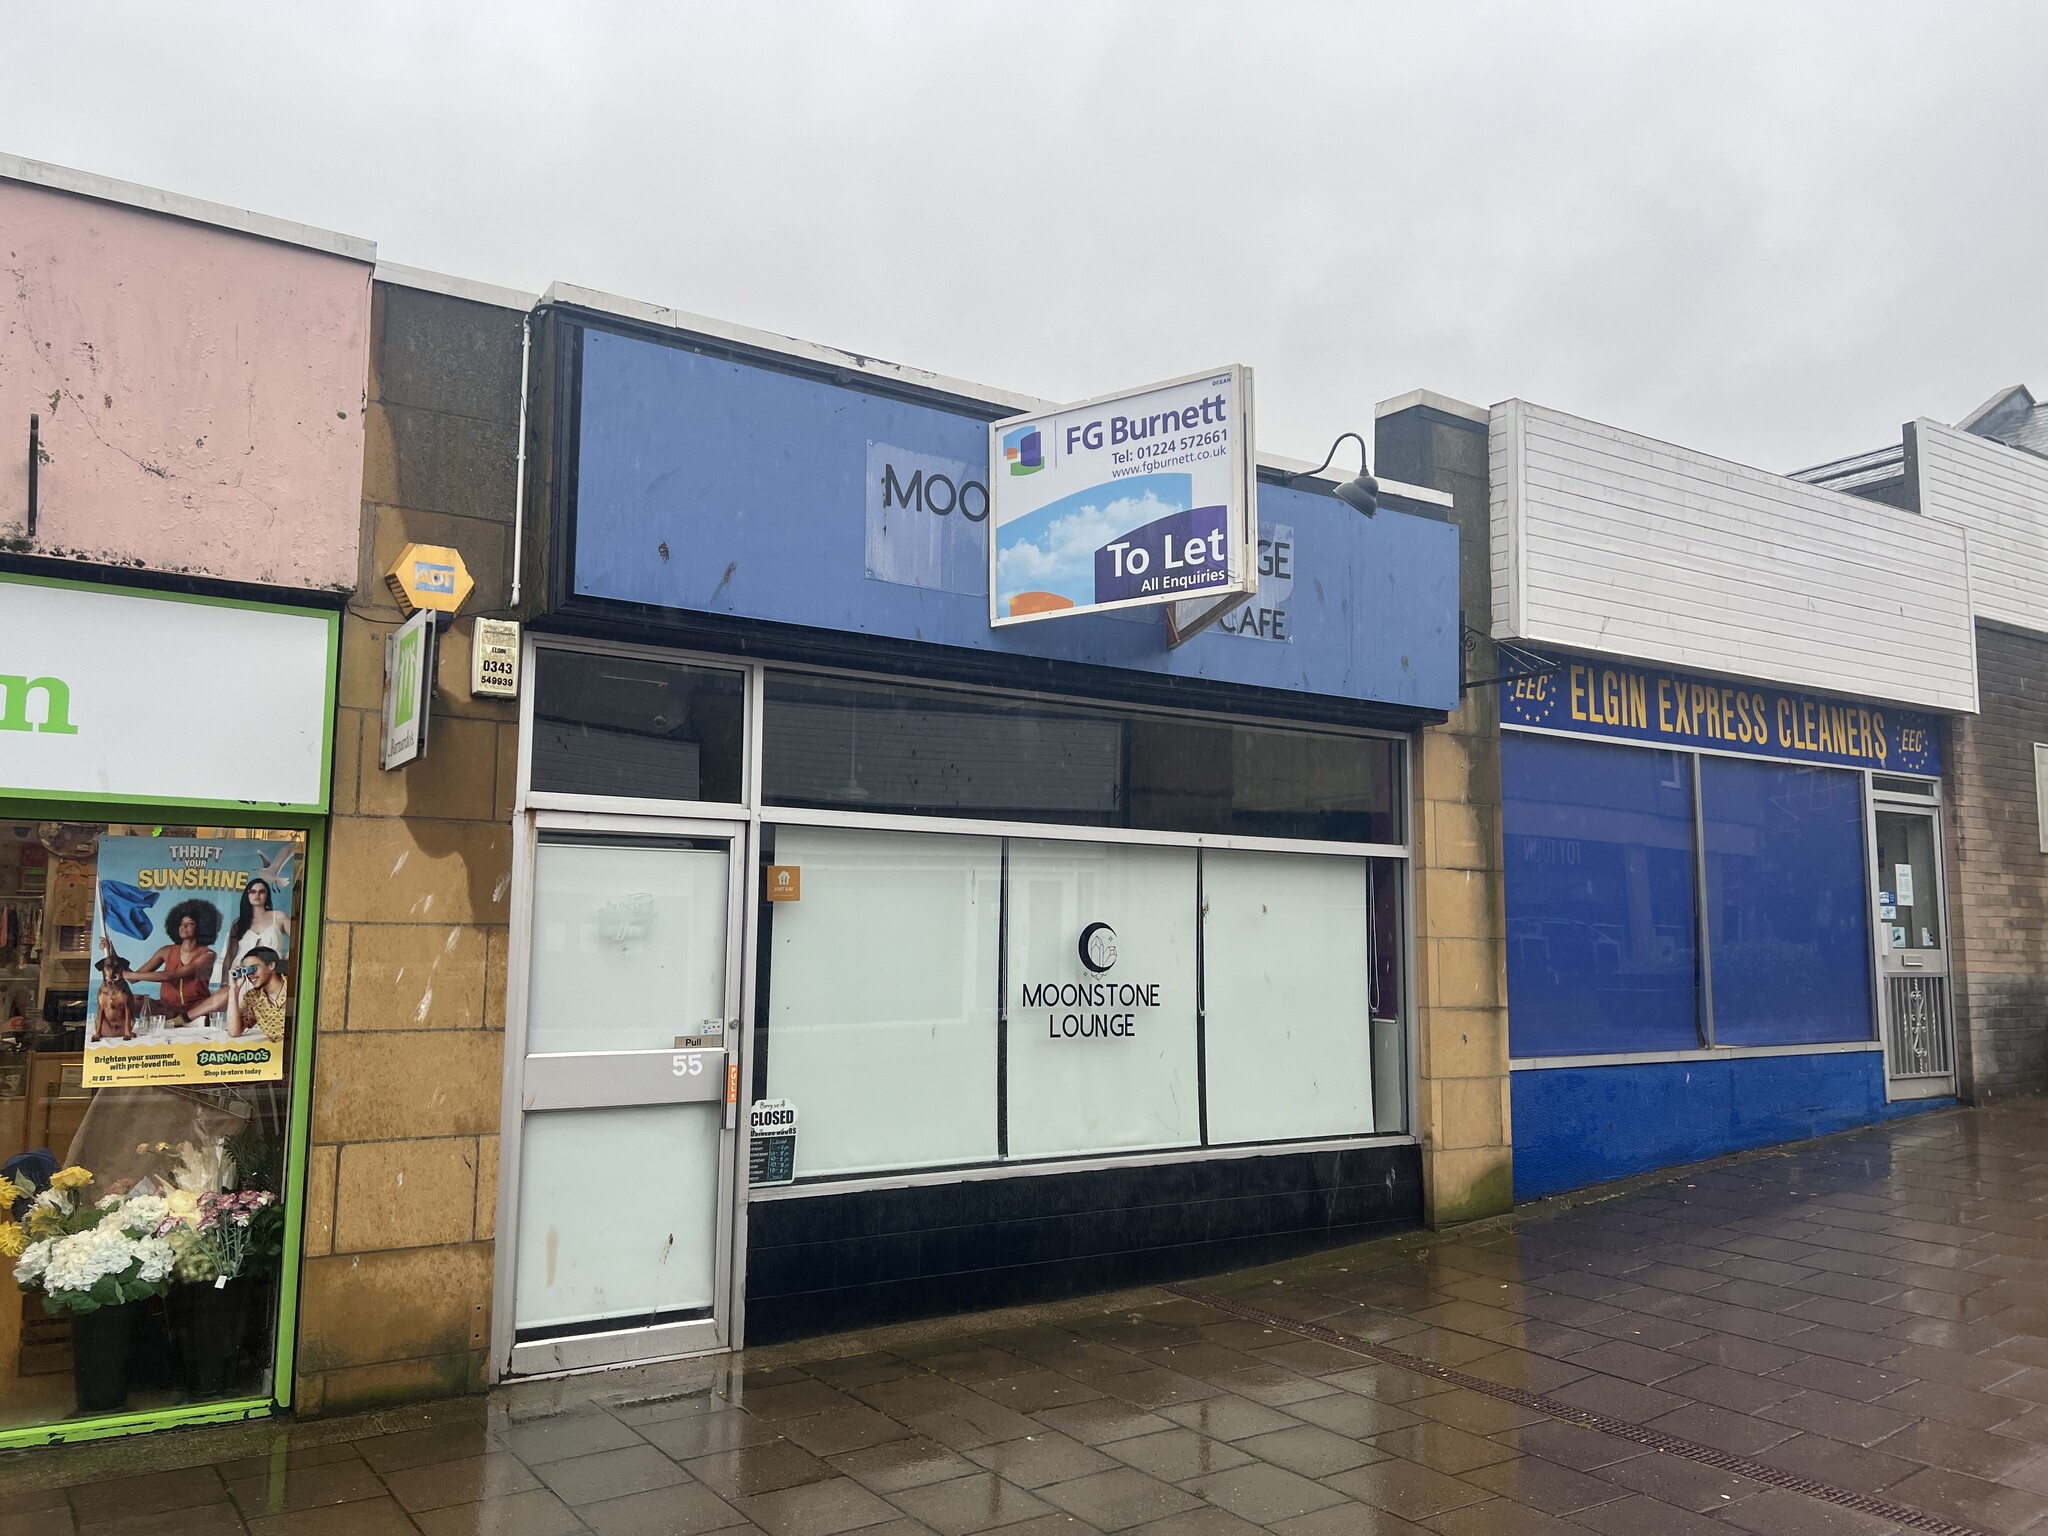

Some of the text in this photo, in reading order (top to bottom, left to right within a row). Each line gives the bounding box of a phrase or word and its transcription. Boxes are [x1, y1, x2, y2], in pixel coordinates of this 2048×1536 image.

[1212, 377, 1231, 386] OCEAN
[1066, 394, 1226, 455] FG Burnett
[1111, 428, 1227, 465] Tel: 01224 572661
[1111, 444, 1227, 478] www.fgburnett.co.uk
[1106, 527, 1225, 578] To Let
[1141, 568, 1226, 593] All Enquiries
[483, 659, 513, 675] 0343
[481, 675, 514, 687] 549939
[1515, 671, 1549, 701] EEC
[1570, 664, 1888, 760] ELGIN EXPRESS CLEANERS
[1901, 728, 1923, 754] EEC
[169, 845, 223, 861] THRIFT
[184, 859, 207, 868] YOUR
[138, 867, 250, 890] SUNSHINE
[1022, 983, 1160, 1007] MOONSTONE
[1049, 1013, 1135, 1038] LOUNGE
[685, 1038, 702, 1047] Pull
[94, 1053, 175, 1065] Brighten your summer
[110, 1059, 181, 1071] with pre-loved finds
[198, 1050, 270, 1065] BARNARDO'S
[672, 1054, 703, 1077] 55
[204, 1068, 262, 1077] Shop in-store today
[750, 1110, 794, 1127] CLOSED
